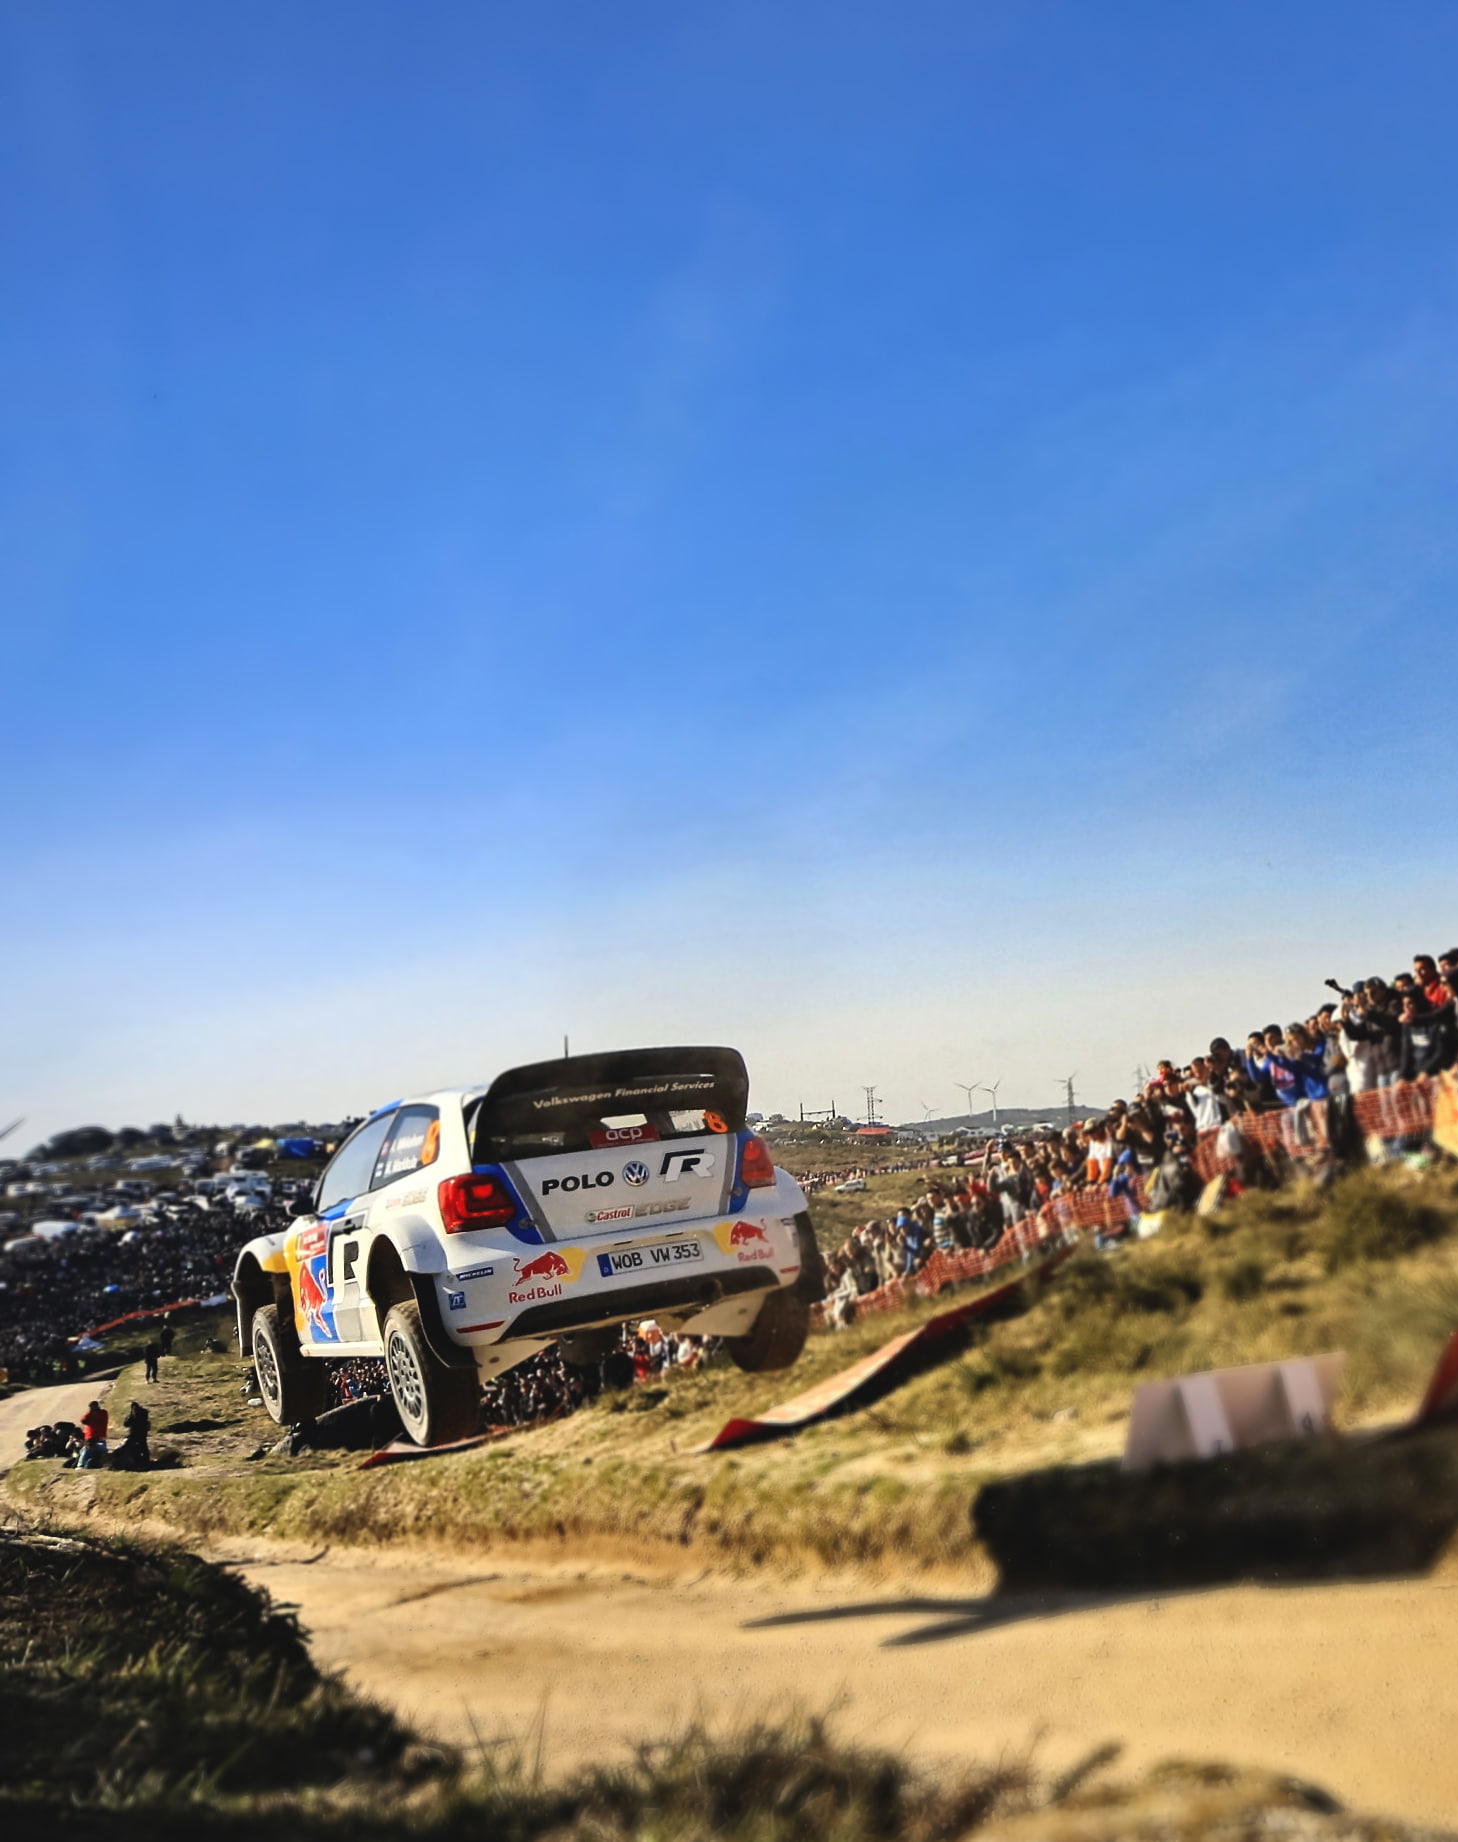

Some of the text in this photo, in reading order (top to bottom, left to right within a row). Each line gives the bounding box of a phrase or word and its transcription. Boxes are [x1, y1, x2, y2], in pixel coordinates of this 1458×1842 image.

[533, 1080, 715, 1109] Volkswagen Financial Services
[542, 1171, 614, 1195] POLO
[597, 1197, 692, 1222] Castrol EDGE
[611, 1252, 643, 1271] WOB
[650, 1248, 671, 1264] VW
[674, 1243, 700, 1260] 353
[737, 1247, 774, 1262] Red Bull
[508, 1283, 562, 1304] Red Bull
